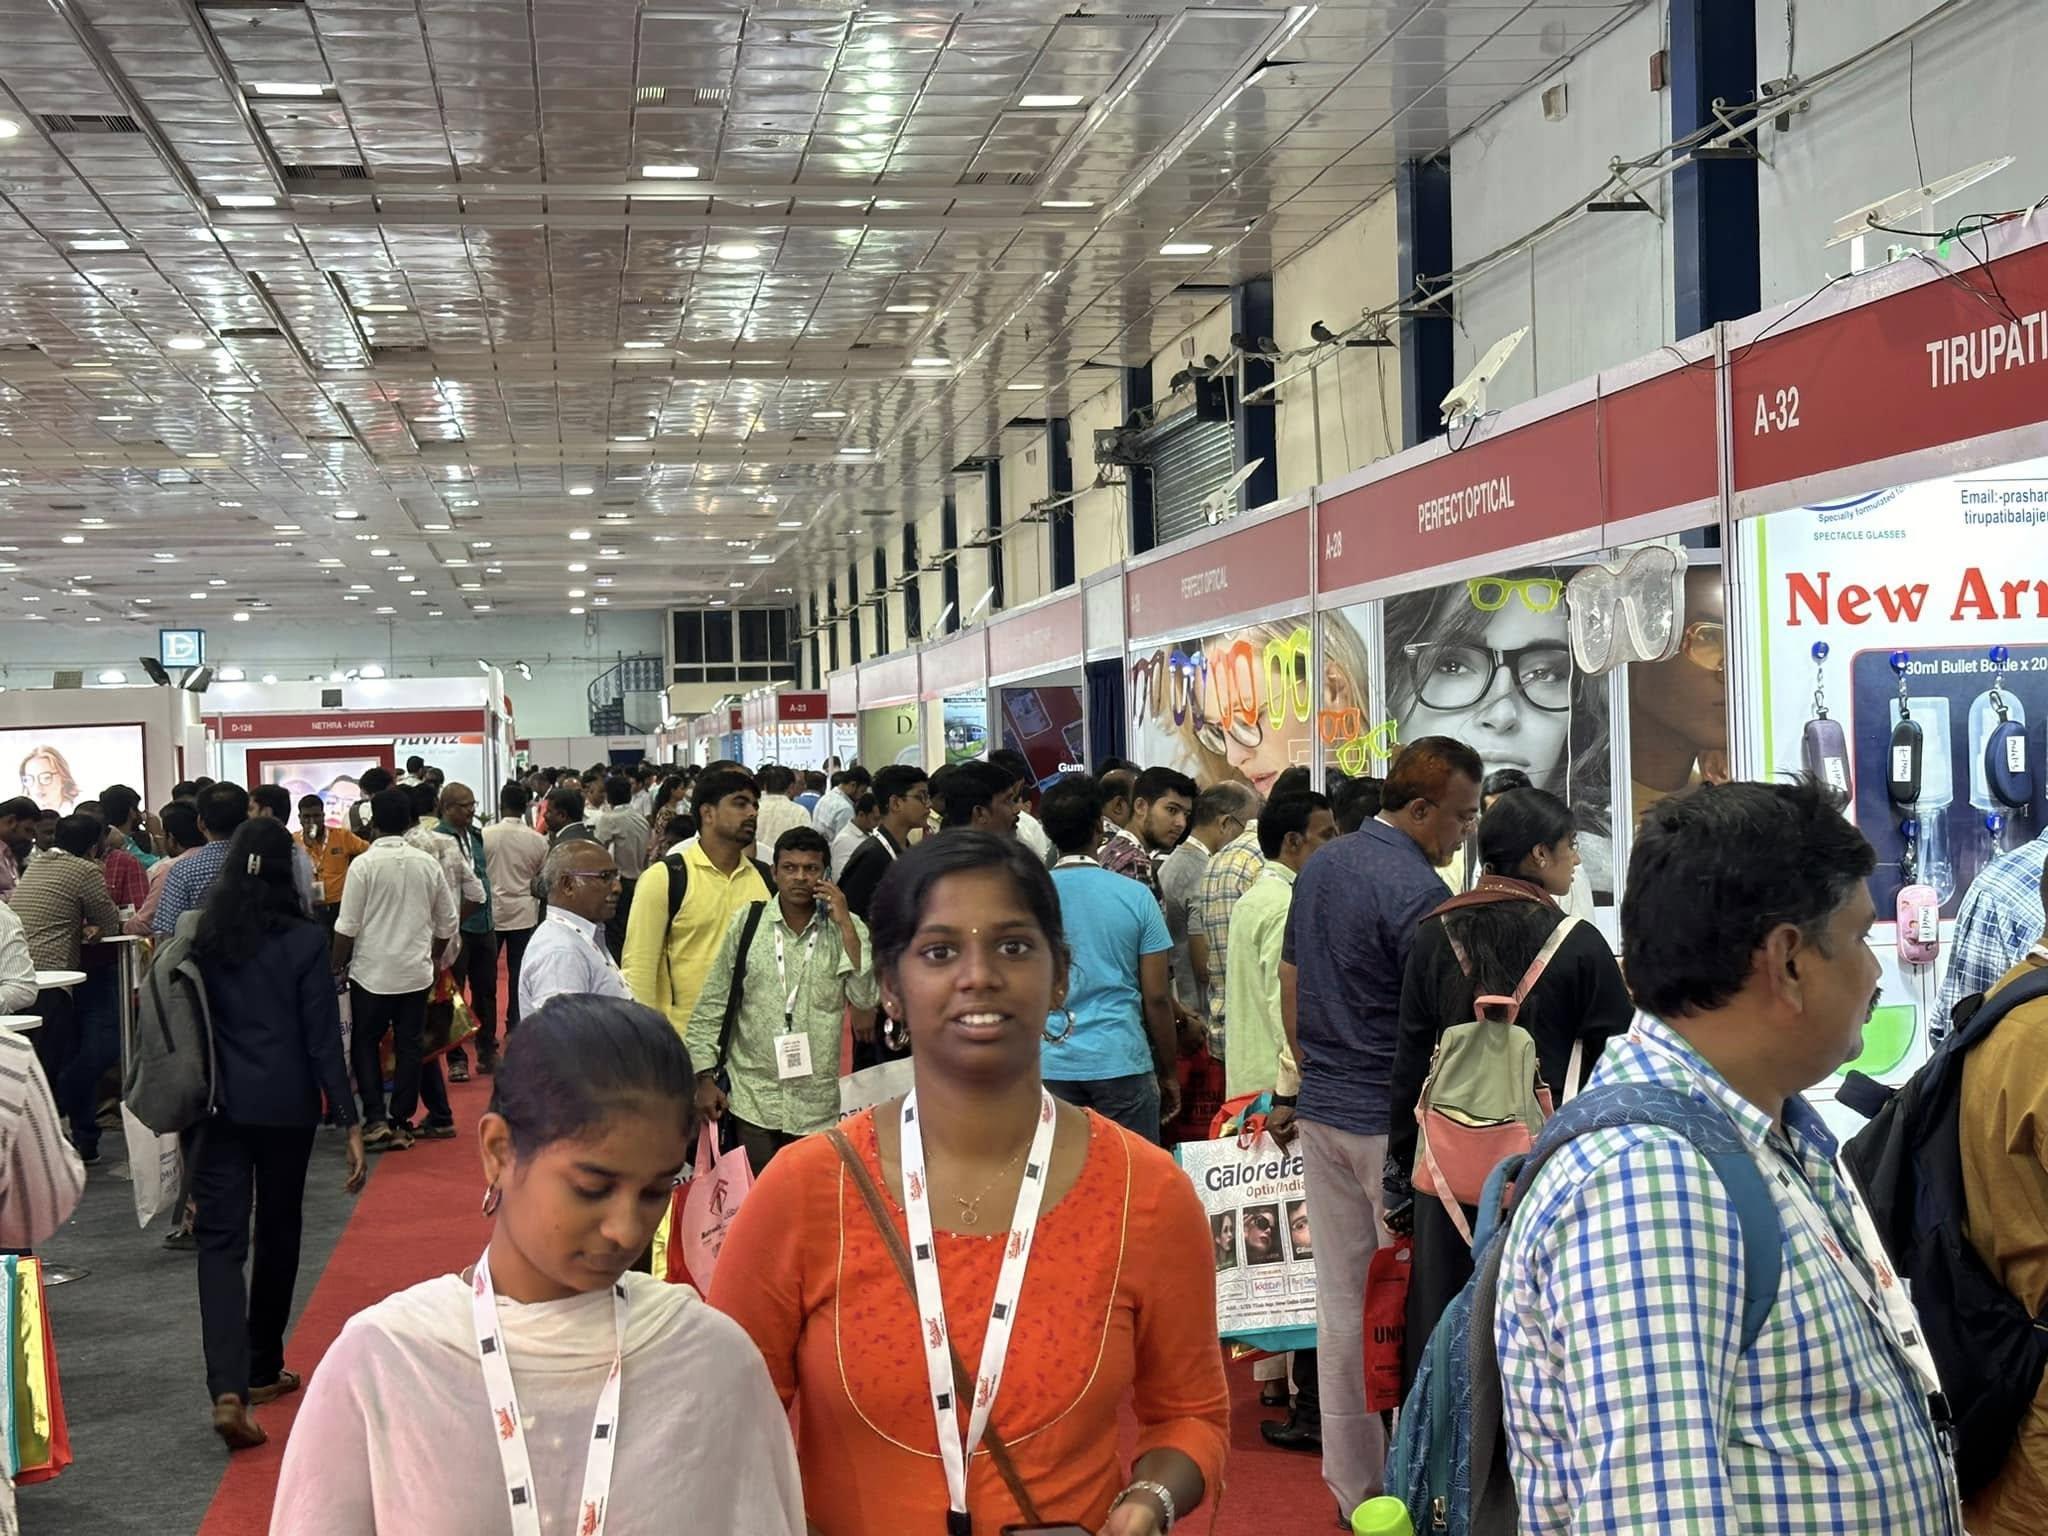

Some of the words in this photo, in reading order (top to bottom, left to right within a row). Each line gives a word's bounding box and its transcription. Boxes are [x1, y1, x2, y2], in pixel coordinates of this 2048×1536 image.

[1926, 311, 2048, 388] TIRUPATI
[1754, 386, 1800, 436] A-32
[1417, 493, 1463, 533] PERFECT
[1465, 475, 1515, 519] OPTICAL
[1818, 510, 1854, 524] Specially
[1855, 491, 1896, 517] formulated
[1965, 507, 2048, 527] tirupatibalajie
[1325, 531, 1343, 560] A-28
[1813, 531, 1864, 541] SPECTACLE
[1865, 529, 1906, 540] GLASSES
[1785, 571, 1929, 626] New
[1905, 660, 1938, 675] 30ml
[1942, 659, 1977, 674] Bullet
[2021, 659, 2028, 671] x
[311, 721, 342, 731] NETHRA
[348, 720, 376, 730] HUVITZ
[1058, 762, 1084, 773] Gum
